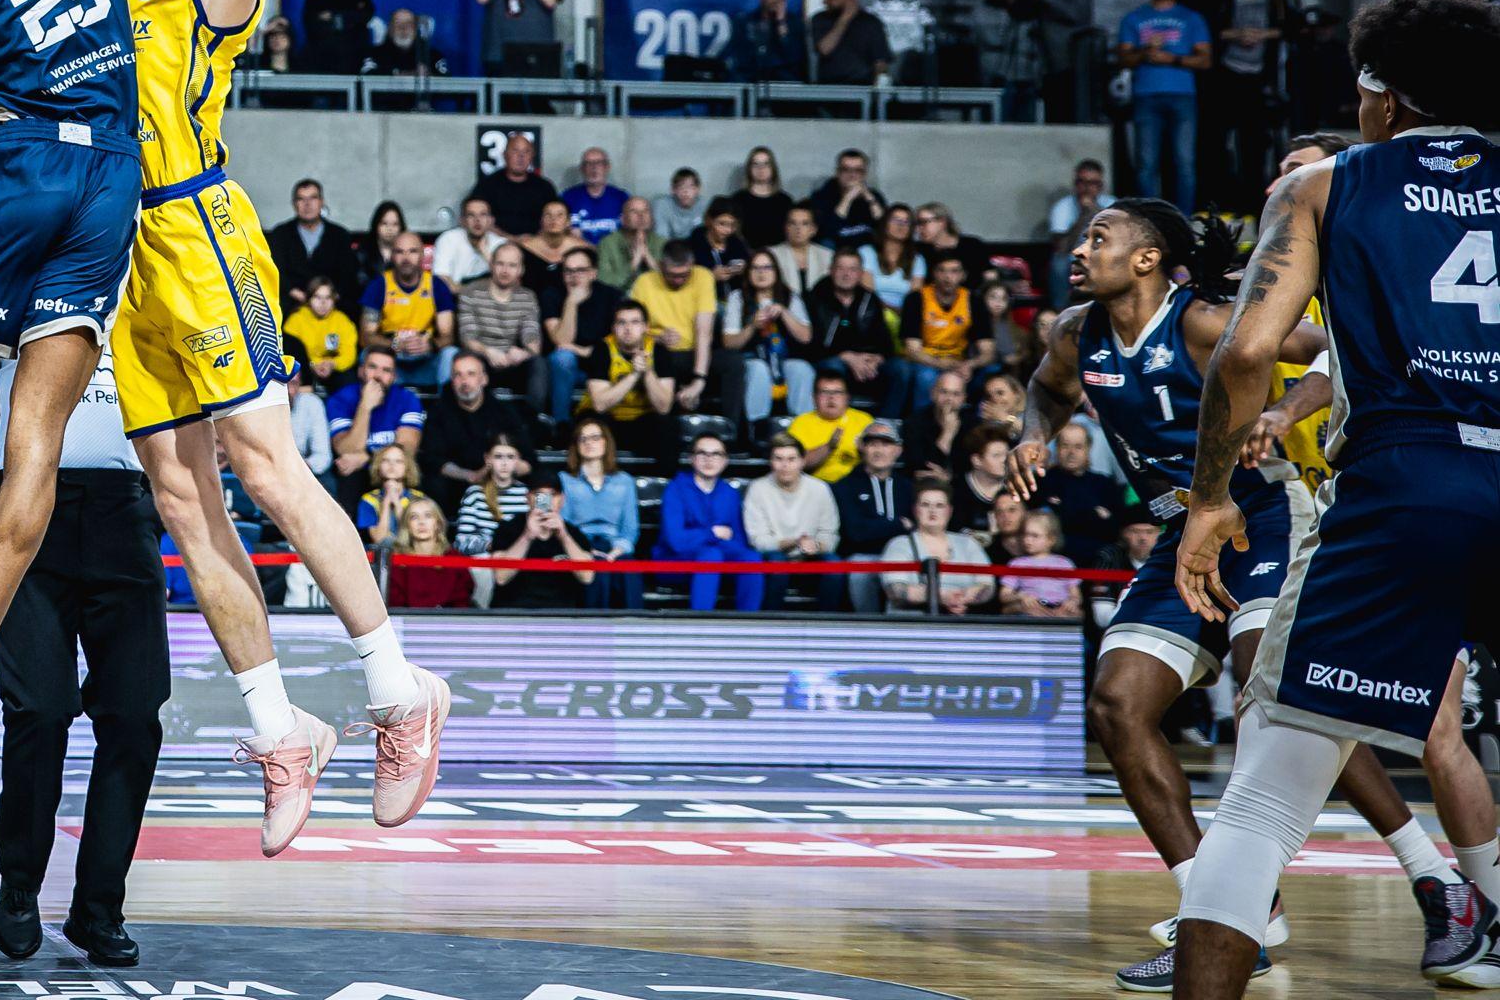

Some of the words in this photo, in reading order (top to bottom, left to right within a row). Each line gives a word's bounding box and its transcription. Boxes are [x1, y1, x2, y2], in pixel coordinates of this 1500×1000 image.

[50, 42, 122, 80] VOLKSWAGEN
[1403, 182, 1500, 217] SOARES
[1430, 230, 1500, 324] 4
[1153, 385, 1175, 422] 1
[1336, 671, 1433, 707] Dantex
[286, 836, 1058, 861] ORLEN
